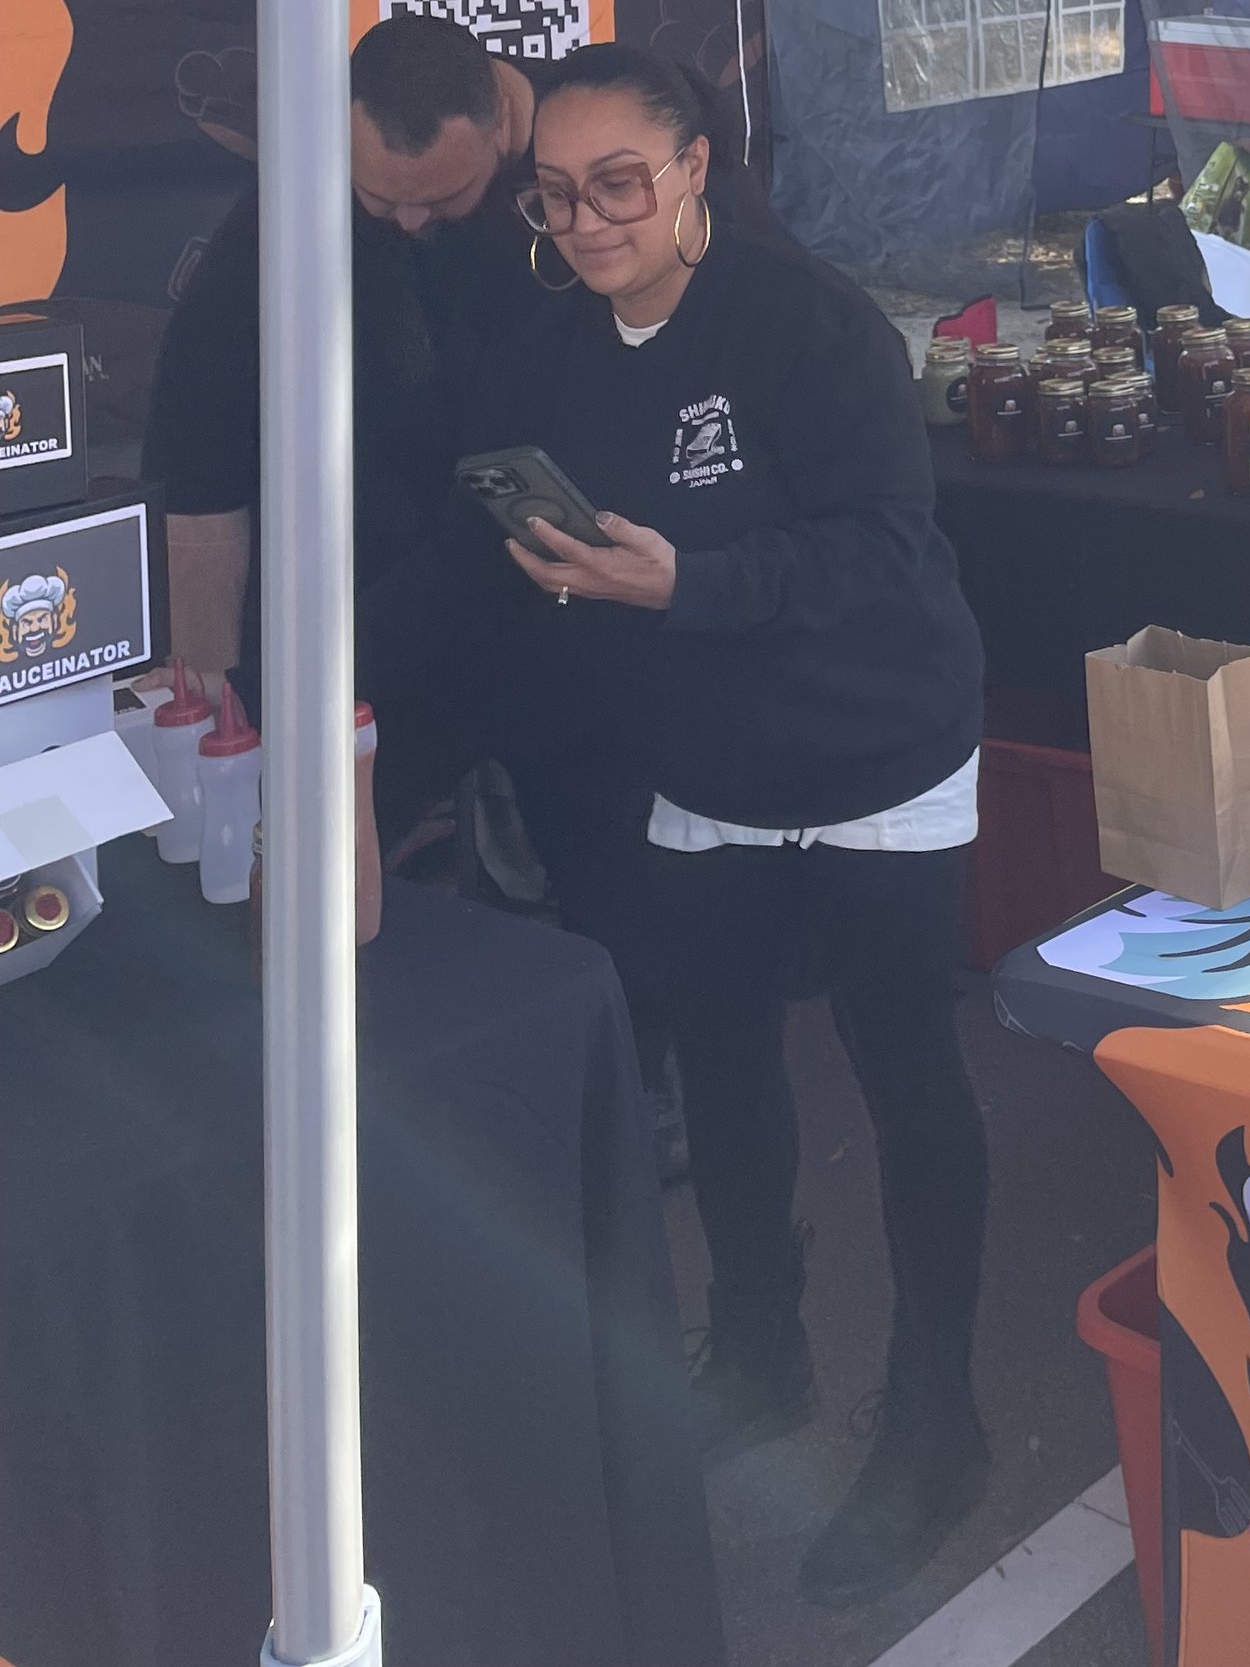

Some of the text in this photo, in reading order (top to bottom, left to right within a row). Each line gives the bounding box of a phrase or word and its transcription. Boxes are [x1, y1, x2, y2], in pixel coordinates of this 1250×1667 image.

[682, 465, 711, 481] SUSHI
[689, 476, 718, 488] JAPAN
[0, 639, 131, 693] AUCEINATOR
